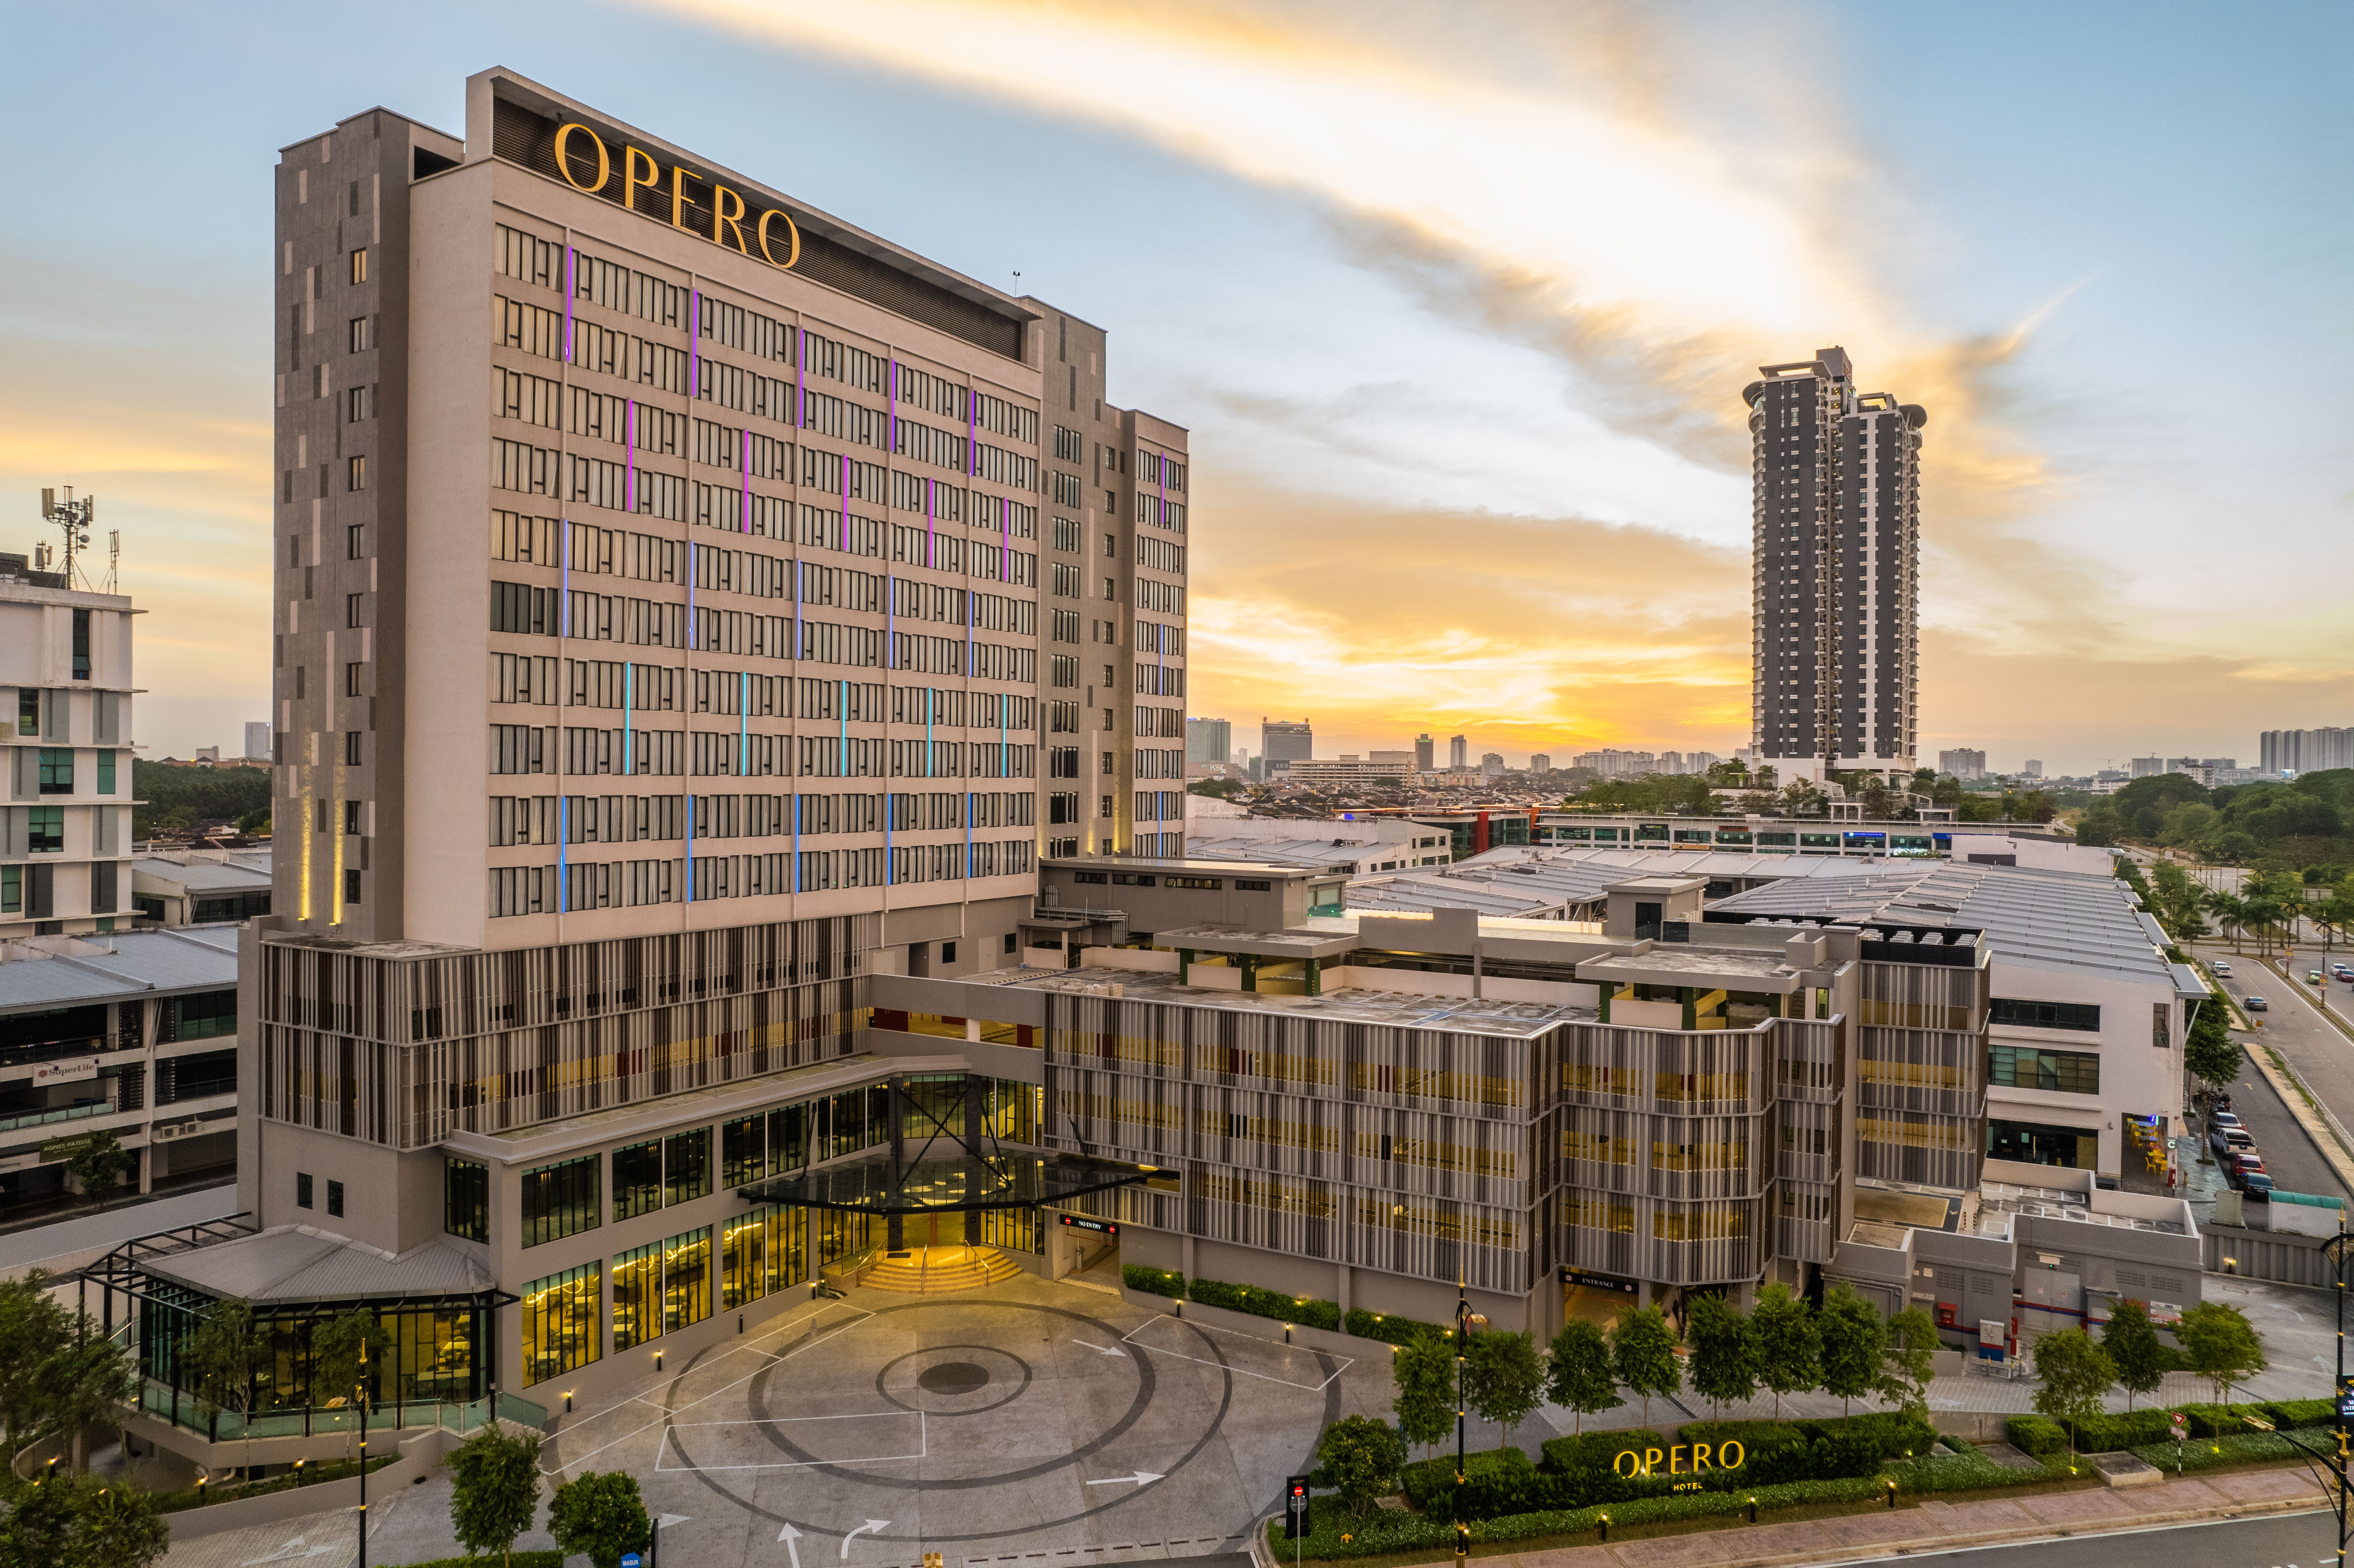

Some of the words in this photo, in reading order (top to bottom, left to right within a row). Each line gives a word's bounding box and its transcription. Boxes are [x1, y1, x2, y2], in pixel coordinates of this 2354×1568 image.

[554, 123, 800, 269] OPERO
[49, 1064, 95, 1076] SuperLife
[1582, 1278, 1614, 1288] ENTRANCE
[1613, 1440, 1745, 1479] OPERO
[1674, 1482, 1703, 1491] HOTEL
